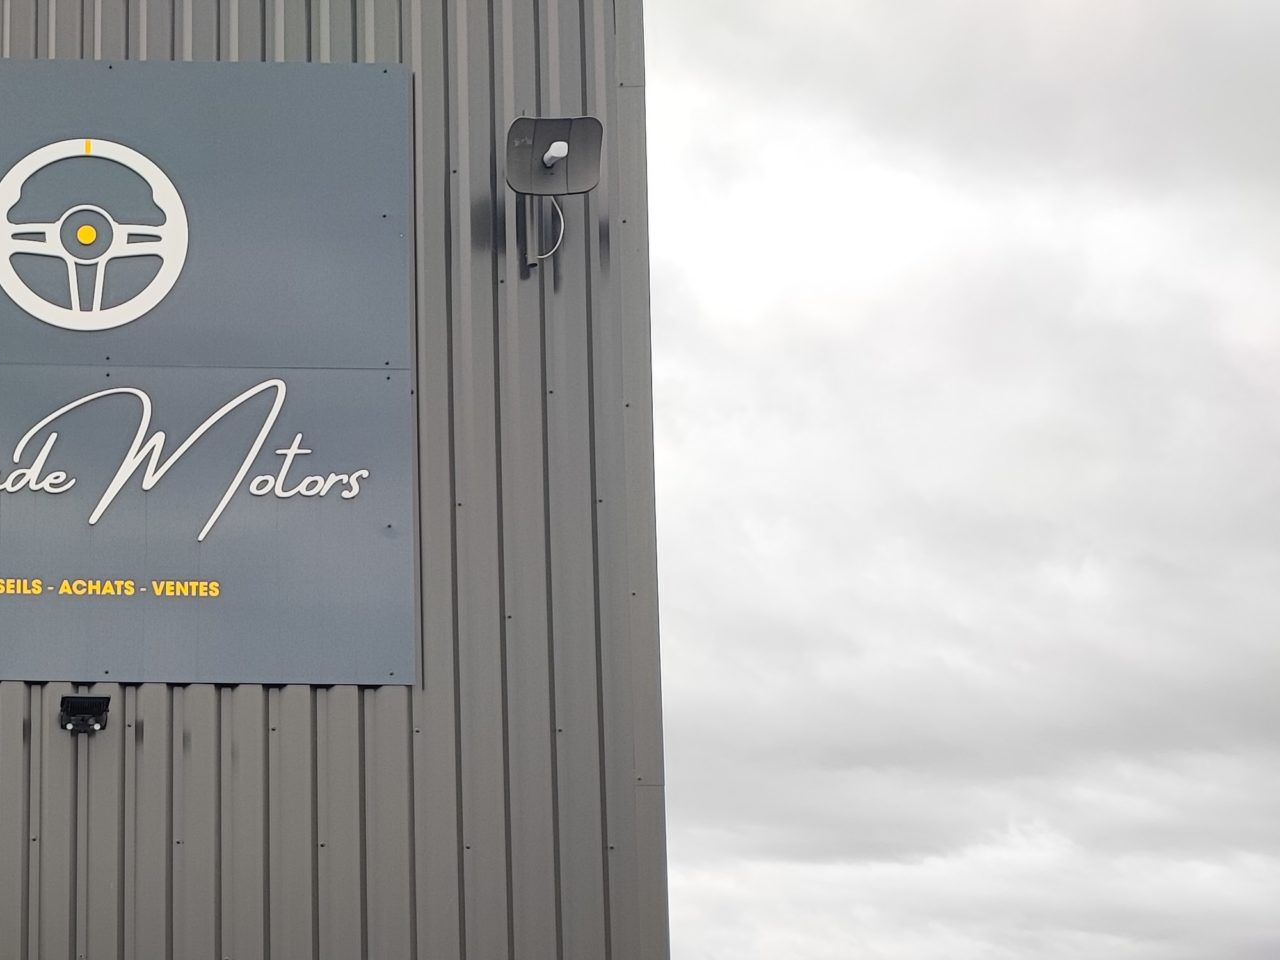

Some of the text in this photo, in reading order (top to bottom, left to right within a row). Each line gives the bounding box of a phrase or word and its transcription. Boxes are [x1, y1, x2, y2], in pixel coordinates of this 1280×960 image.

[13, 378, 370, 542] Motors
[58, 579, 136, 596] ACHATS
[151, 580, 221, 597] VENTES
